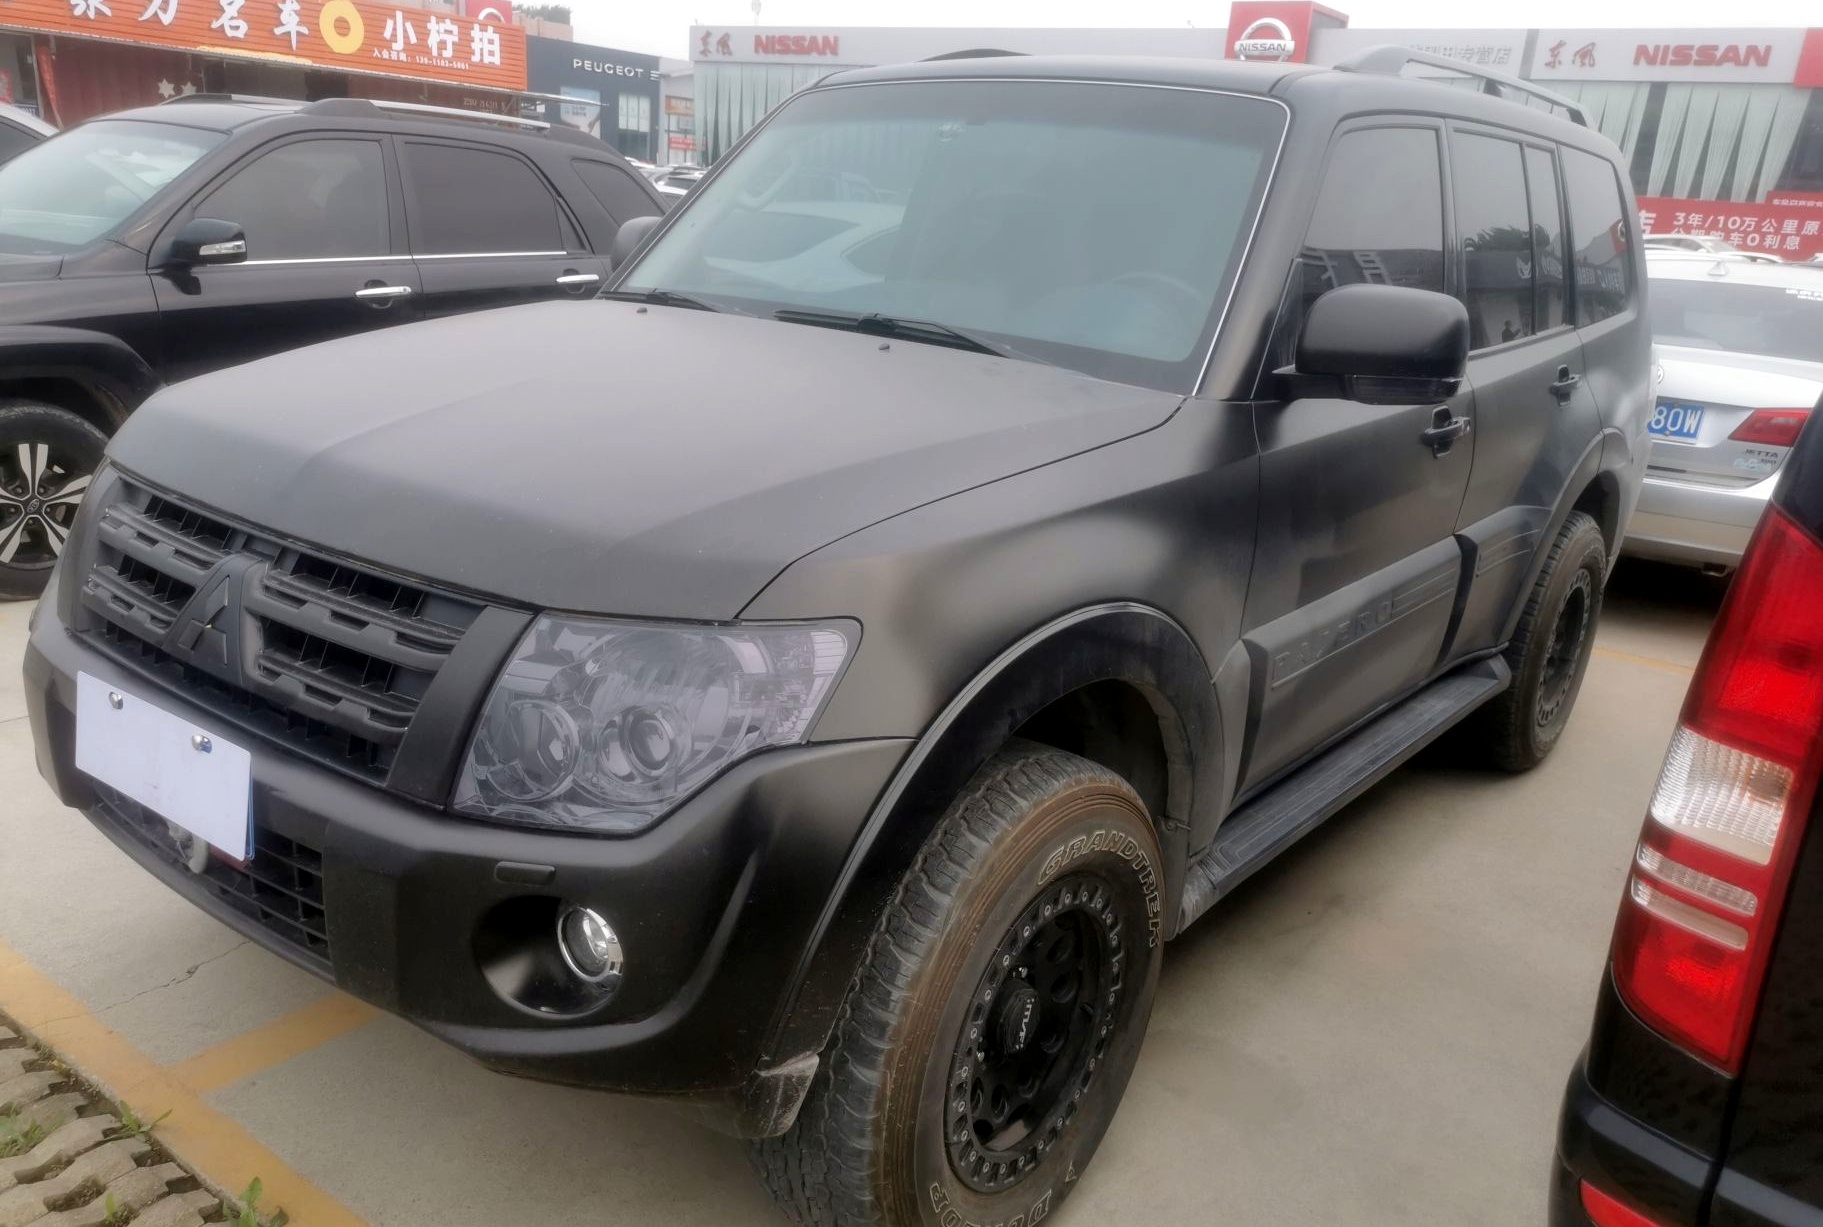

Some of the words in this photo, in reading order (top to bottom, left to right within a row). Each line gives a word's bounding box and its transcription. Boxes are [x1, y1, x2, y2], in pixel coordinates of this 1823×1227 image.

[383, 10, 501, 66] 小柠拍
[753, 34, 840, 57] NISSAN
[1238, 42, 1287, 53] NISSAN
[1544, 40, 1597, 69] 东风
[1632, 43, 1773, 68] NISSAN
[573, 58, 645, 78] PEUGEOT
[1743, 447, 1779, 459] JETTA
[1037, 830, 1161, 949] GRANDTREK
